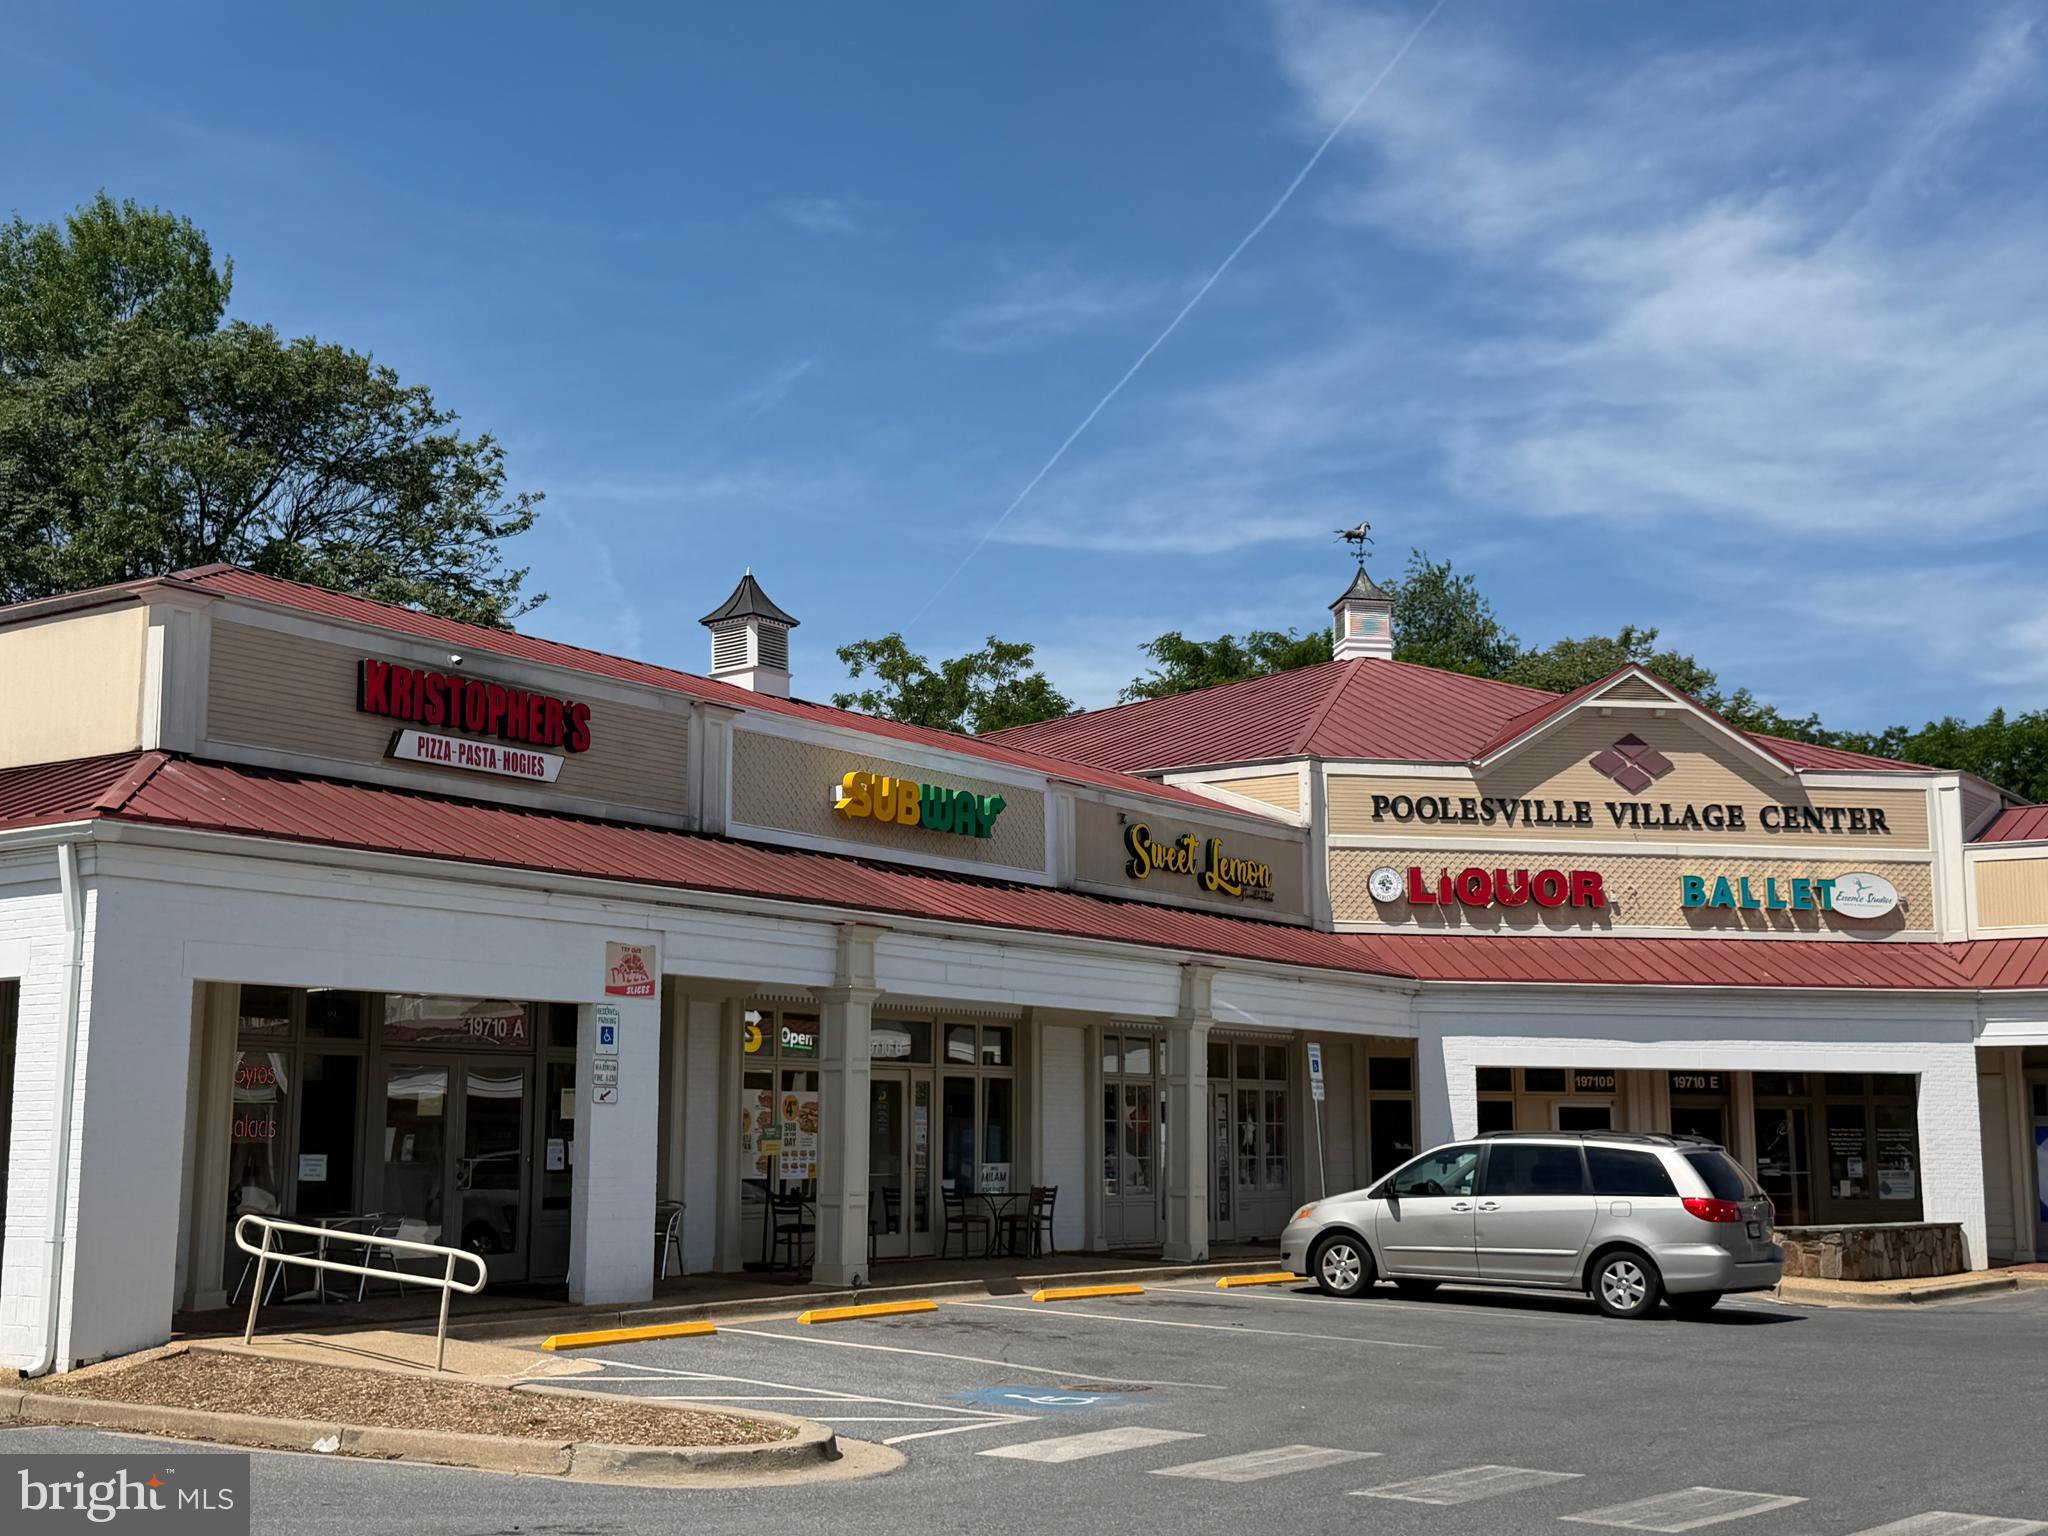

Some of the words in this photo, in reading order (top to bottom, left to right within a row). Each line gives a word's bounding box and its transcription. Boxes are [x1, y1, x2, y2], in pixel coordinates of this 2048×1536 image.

[361, 658, 591, 752] KRISTOPHER'S
[834, 771, 1007, 839] SUBWAY
[1371, 795, 1593, 824] POOLESVILLE
[1605, 801, 1745, 828] VILLAGE
[1759, 805, 1891, 832] CENTER
[1127, 822, 1200, 880] Sweet
[1203, 837, 1272, 896] Lemon
[1407, 867, 1606, 908] LIQUOR
[1681, 875, 1836, 911] BALLET
[626, 984, 650, 995] SLICES
[466, 1016, 508, 1037] 19710
[512, 1022, 525, 1038] A
[781, 1026, 813, 1048] Open
[234, 1060, 276, 1089] Gyros
[1672, 1076, 1705, 1089] 19710
[1710, 1076, 1719, 1089] E
[232, 1114, 277, 1138] alads
